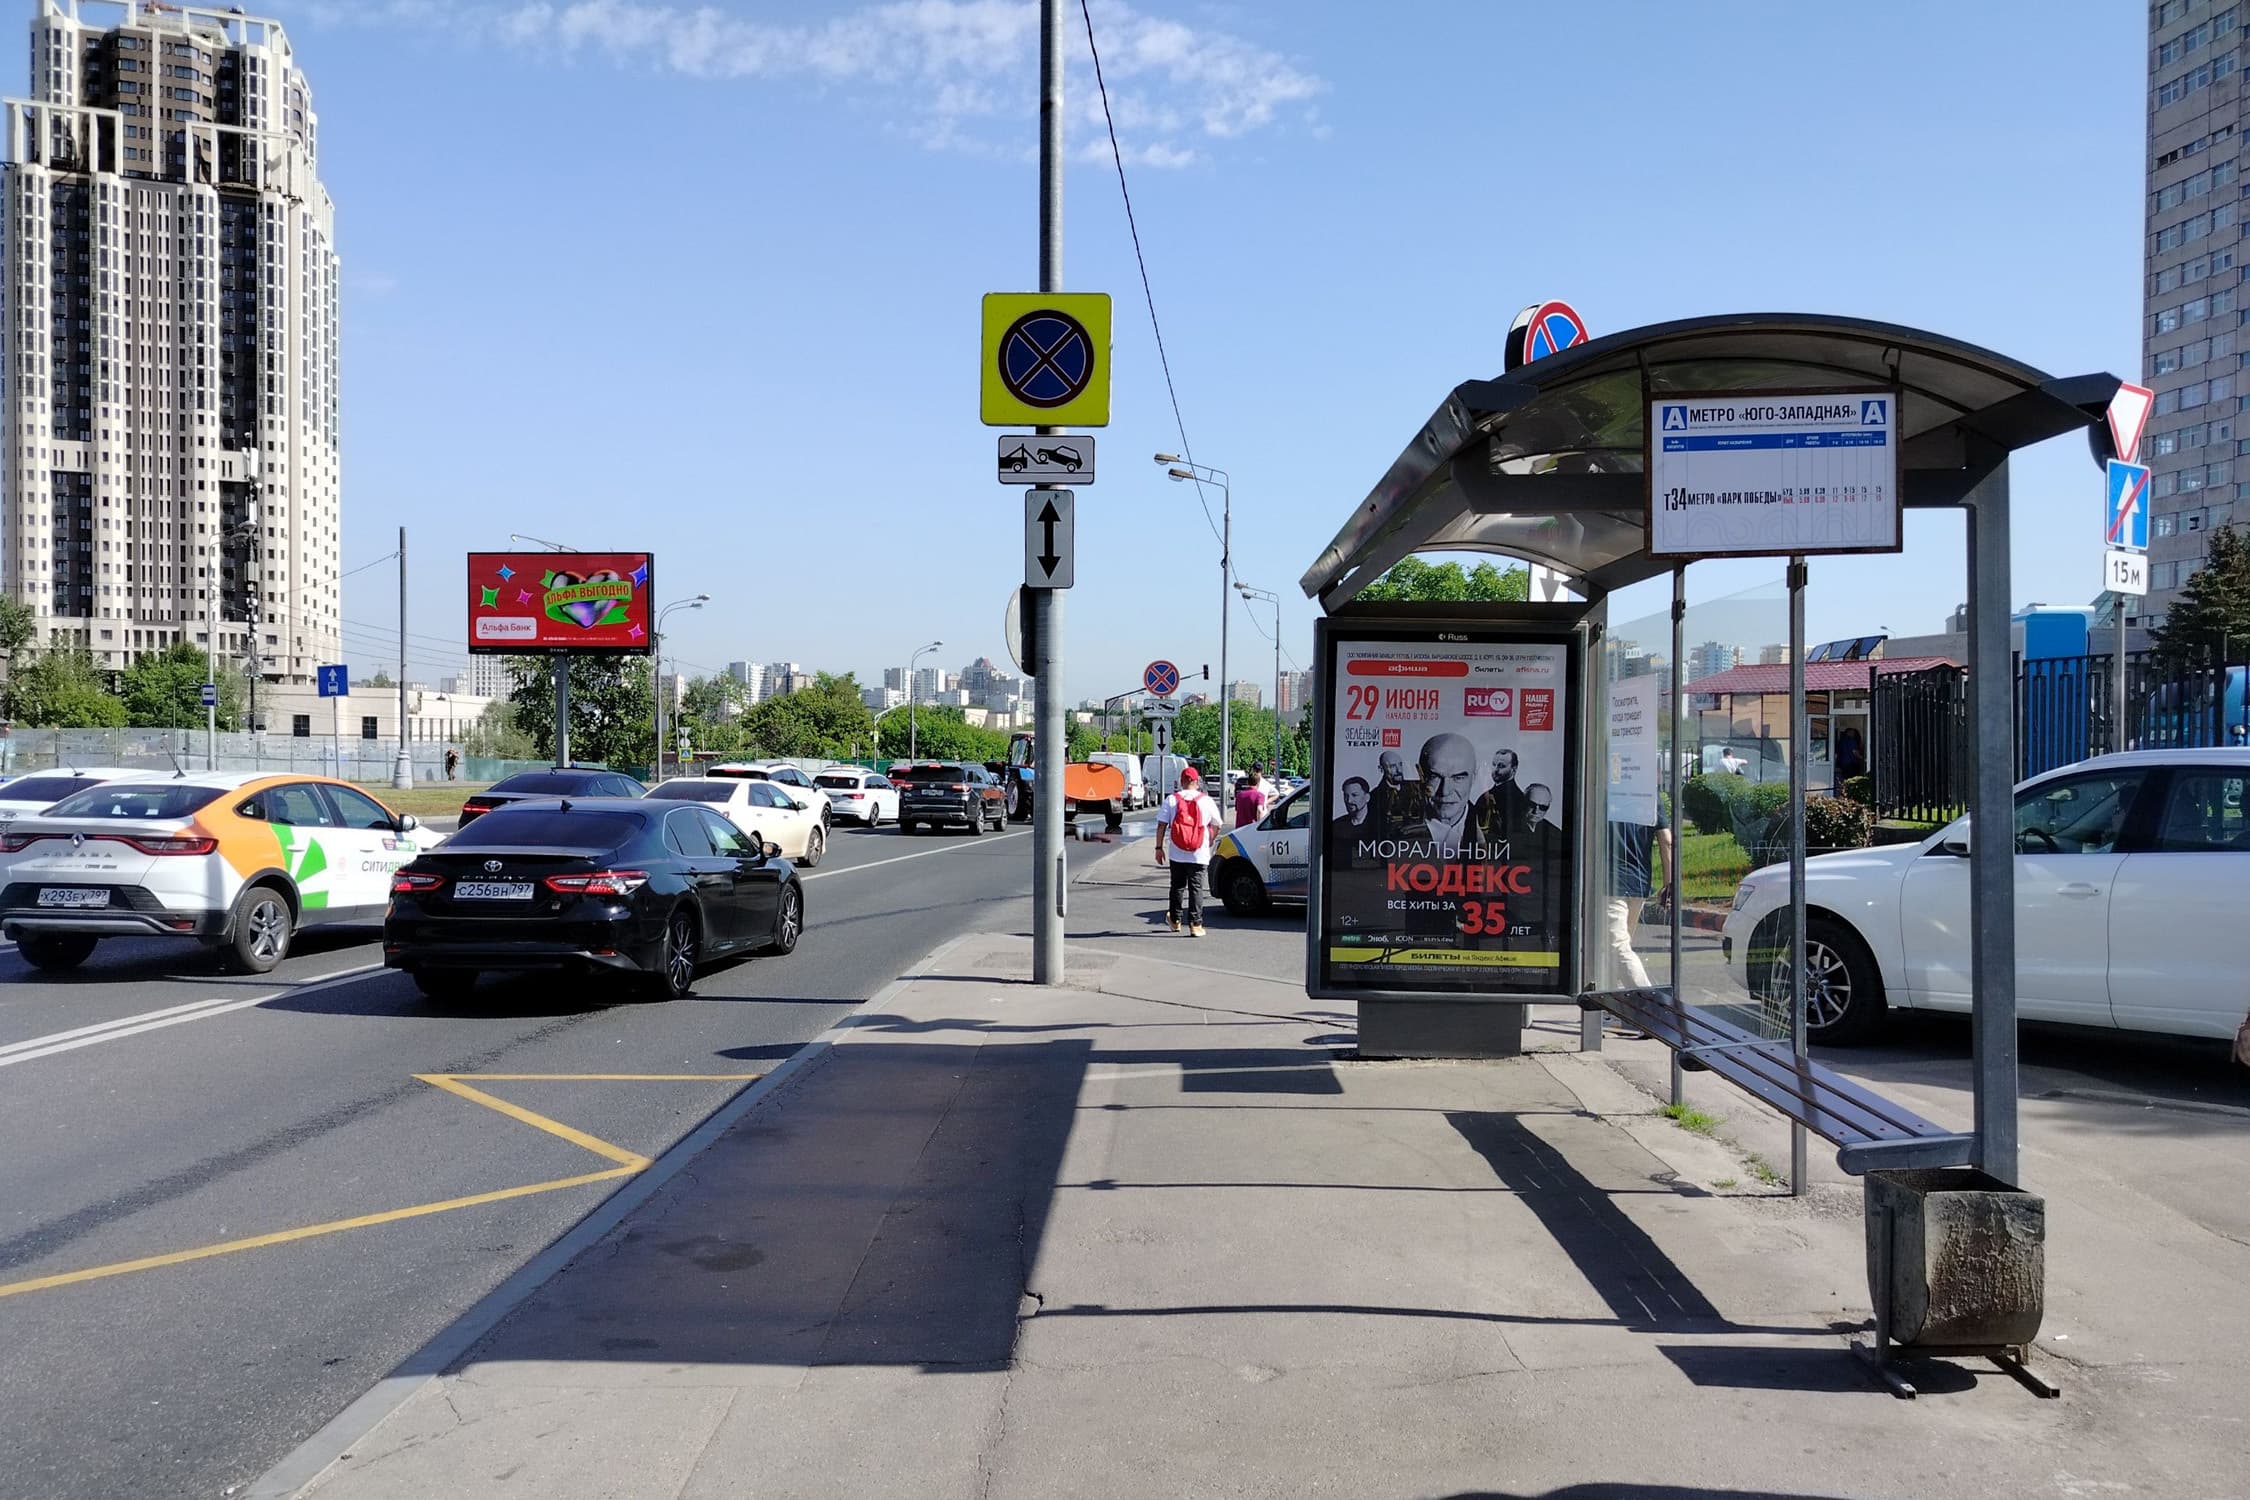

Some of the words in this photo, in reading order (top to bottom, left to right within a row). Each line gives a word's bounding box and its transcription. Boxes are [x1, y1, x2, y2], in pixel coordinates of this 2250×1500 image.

[1689, 408, 1735, 423] МЕТРО
[1738, 405, 1857, 421] «ЮГО-ЗАПАДНАЯ»
[1687, 493, 1715, 505] МЕТРО
[1717, 492, 1742, 505] «ПАРК
[1744, 491, 1782, 505] ПОБЕДЫ»
[2113, 560, 2129, 584] 15
[546, 591, 577, 605] АЛЬФА
[579, 585, 629, 599] ВЫГОДНО
[481, 623, 510, 633] Альфа
[511, 623, 532, 632] Банк
[1447, 633, 1469, 641] Russ
[1388, 663, 1429, 673] афиша
[1474, 665, 1505, 673] билеты
[1346, 685, 1380, 721] 29
[1385, 689, 1440, 710] ИЮНЯ
[1467, 695, 1490, 707] RU
[1525, 694, 1550, 703] НАШЕ
[1385, 711, 1411, 720] НАЧАЛО
[1345, 725, 1380, 741] ЗЕЛЁНЫЙ
[1270, 841, 1290, 856] 161
[1358, 839, 1511, 861] МОРАЛЬНЫЙ
[1387, 863, 1532, 897] КОДЕКС
[1340, 915, 1359, 926] 12+
[1387, 900, 1407, 910] ВСЕ
[1409, 901, 1440, 911] ХИТЫ
[1442, 901, 1456, 911] ЗА
[1462, 900, 1506, 935] 35
[1510, 926, 1532, 936] ЛЕТ
[1411, 952, 1461, 960] БИЛЕТЫ
